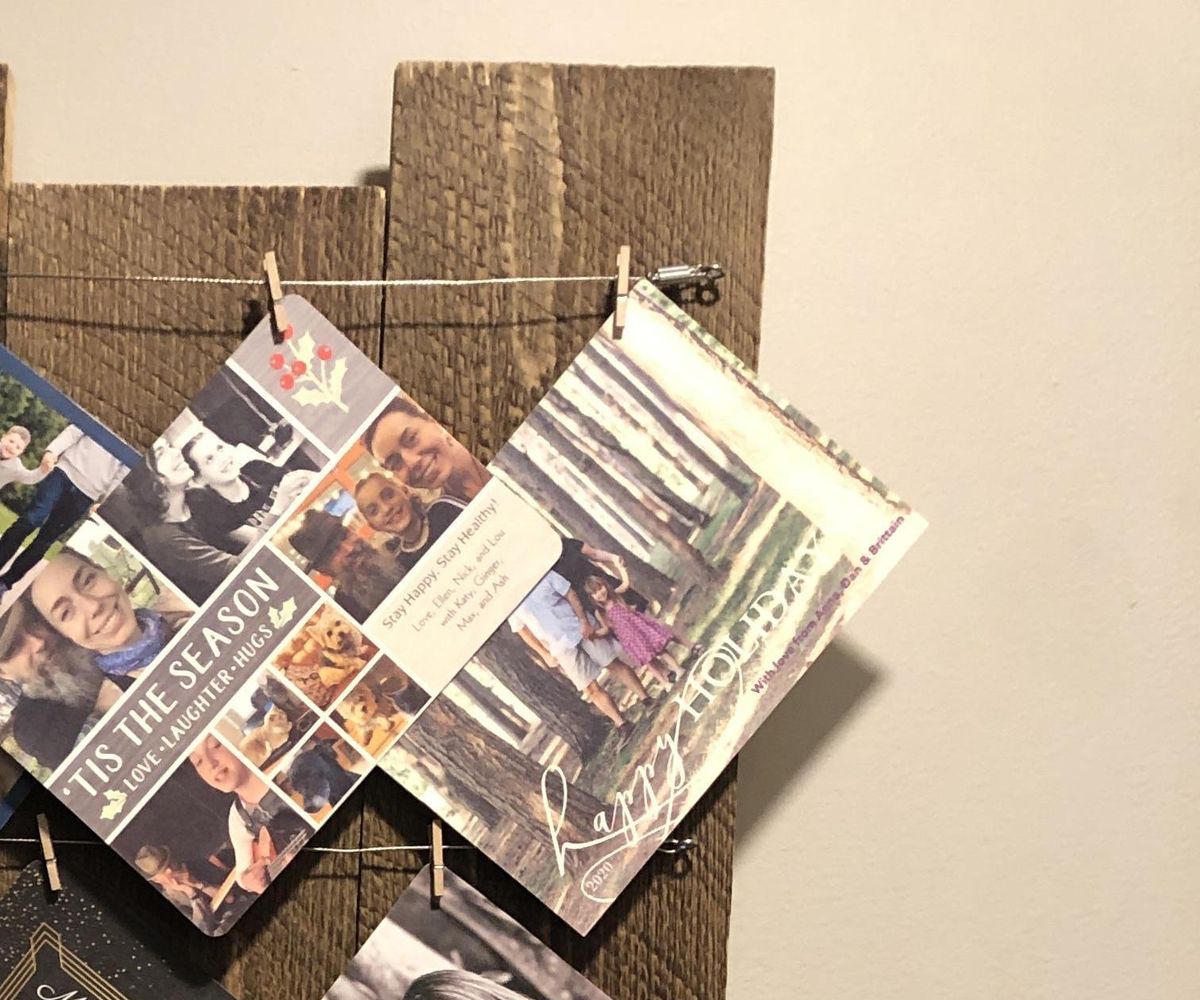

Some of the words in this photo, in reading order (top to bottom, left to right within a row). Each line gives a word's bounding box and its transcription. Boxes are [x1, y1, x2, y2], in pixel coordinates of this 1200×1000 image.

[381, 599, 408, 631] Stay
[436, 542, 462, 569] Stay
[458, 498, 502, 544] Healthy!
[476, 545, 492, 563] and
[489, 529, 506, 548] Lou
[480, 589, 494, 610] and
[62, 743, 123, 797] 'TIS
[112, 682, 178, 746] THE
[169, 567, 280, 690] SEASON
[440, 606, 458, 627] with
[673, 525, 827, 723] HOLIDAY
[751, 669, 777, 694] With
[772, 646, 795, 672] love
[792, 620, 817, 646] from
[840, 566, 862, 589] Dan
[860, 555, 871, 566] &
[123, 752, 162, 792] LOVE
[161, 673, 234, 749] LAUGHTER
[233, 623, 273, 668] HUGS
[586, 861, 613, 892] 2020
